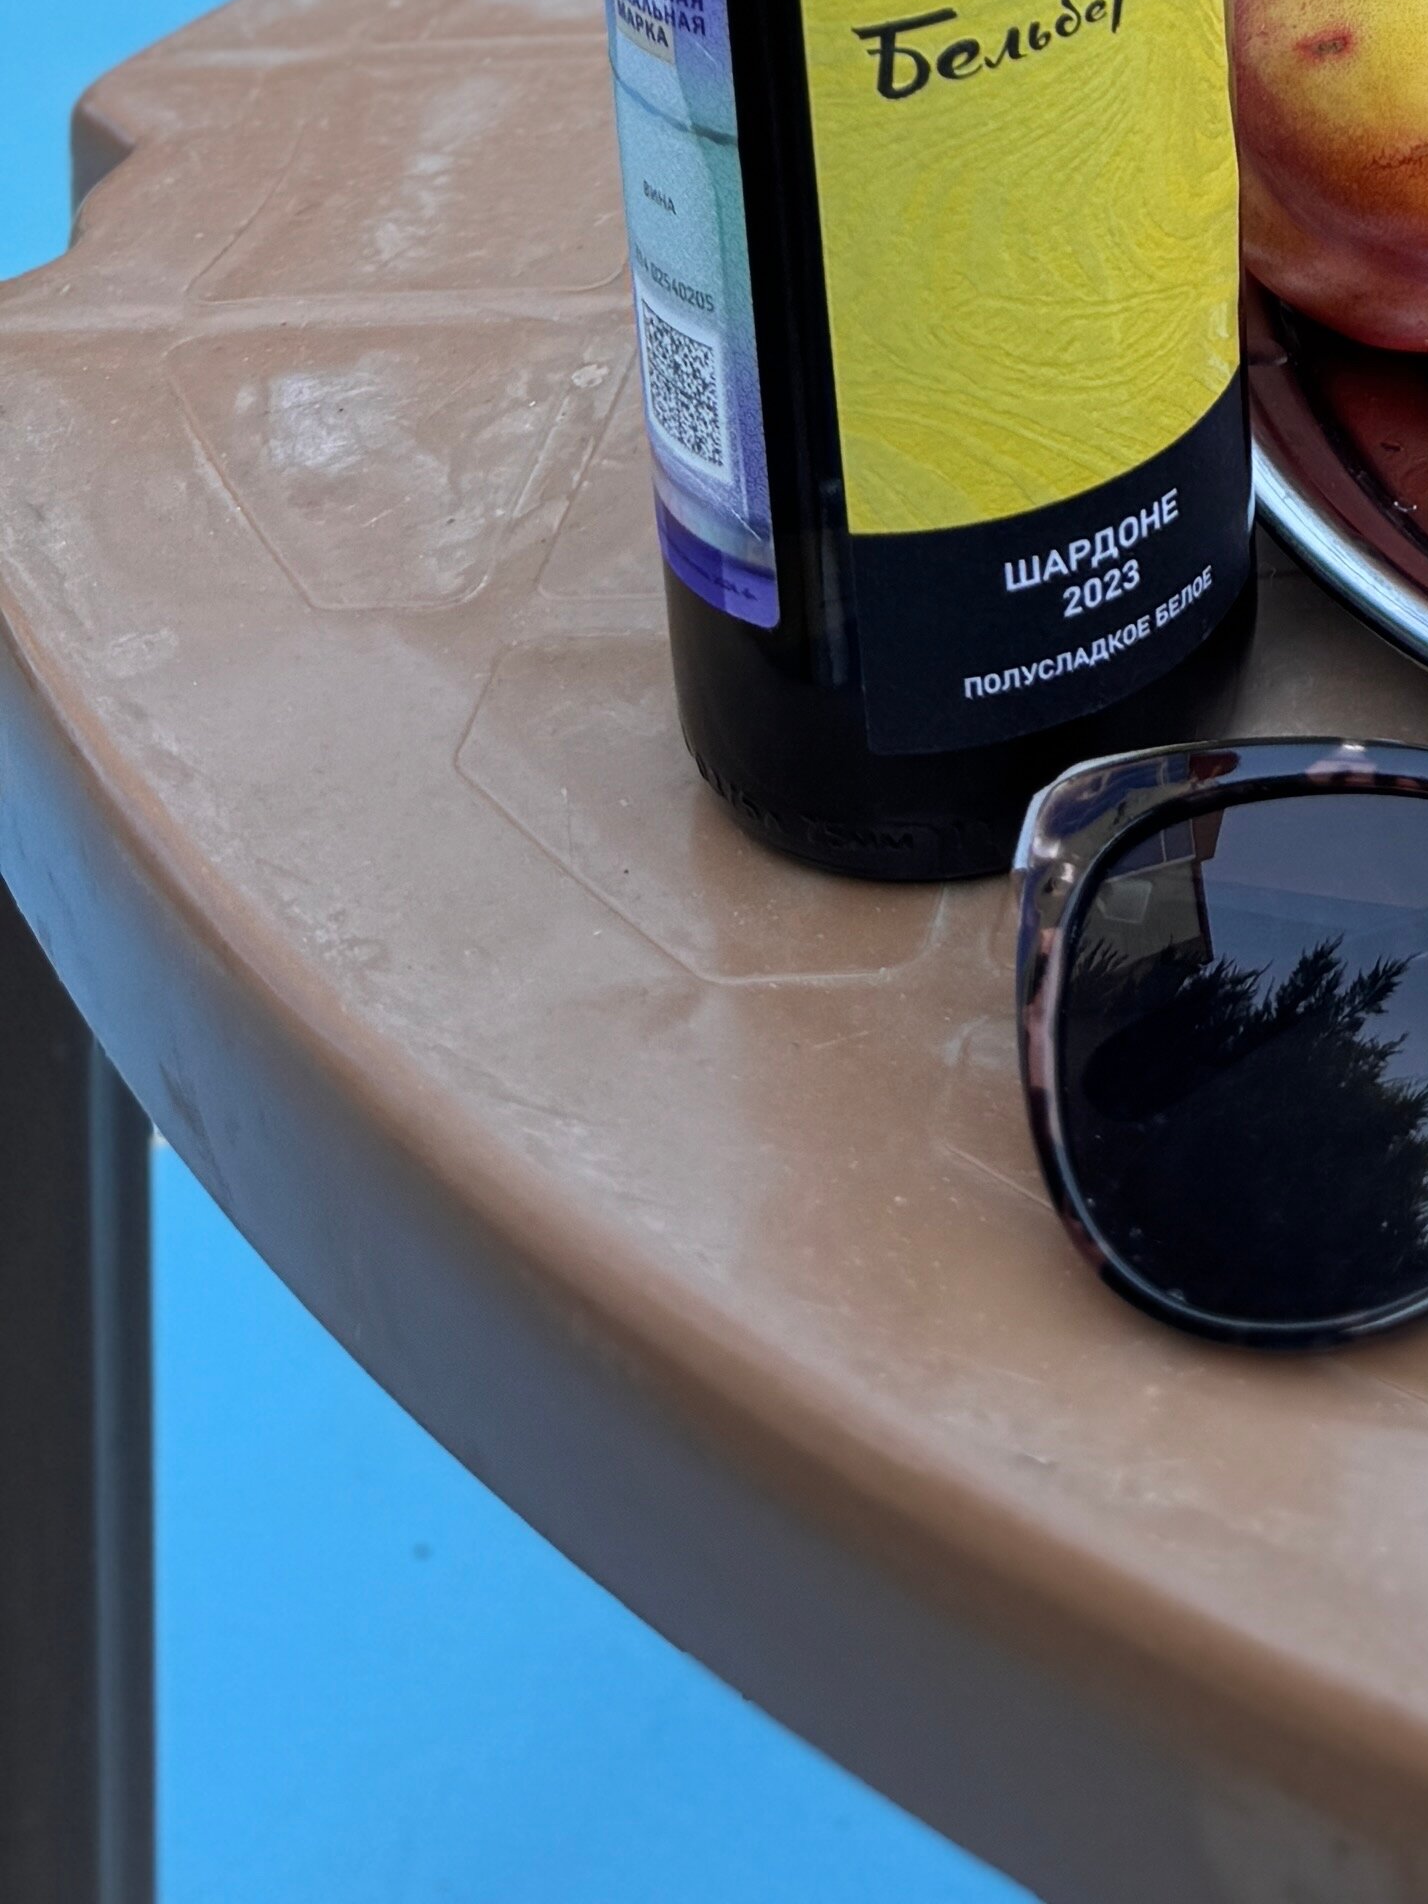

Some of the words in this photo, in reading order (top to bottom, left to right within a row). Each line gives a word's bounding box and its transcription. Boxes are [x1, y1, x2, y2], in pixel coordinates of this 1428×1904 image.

[1003, 487, 1181, 592] ШАРДОНЕ
[1062, 558, 1141, 618] 2023
[963, 614, 1151, 700] ПОЛУСЛАДКОЕ
[1154, 564, 1214, 629] БЕЛОЕ
